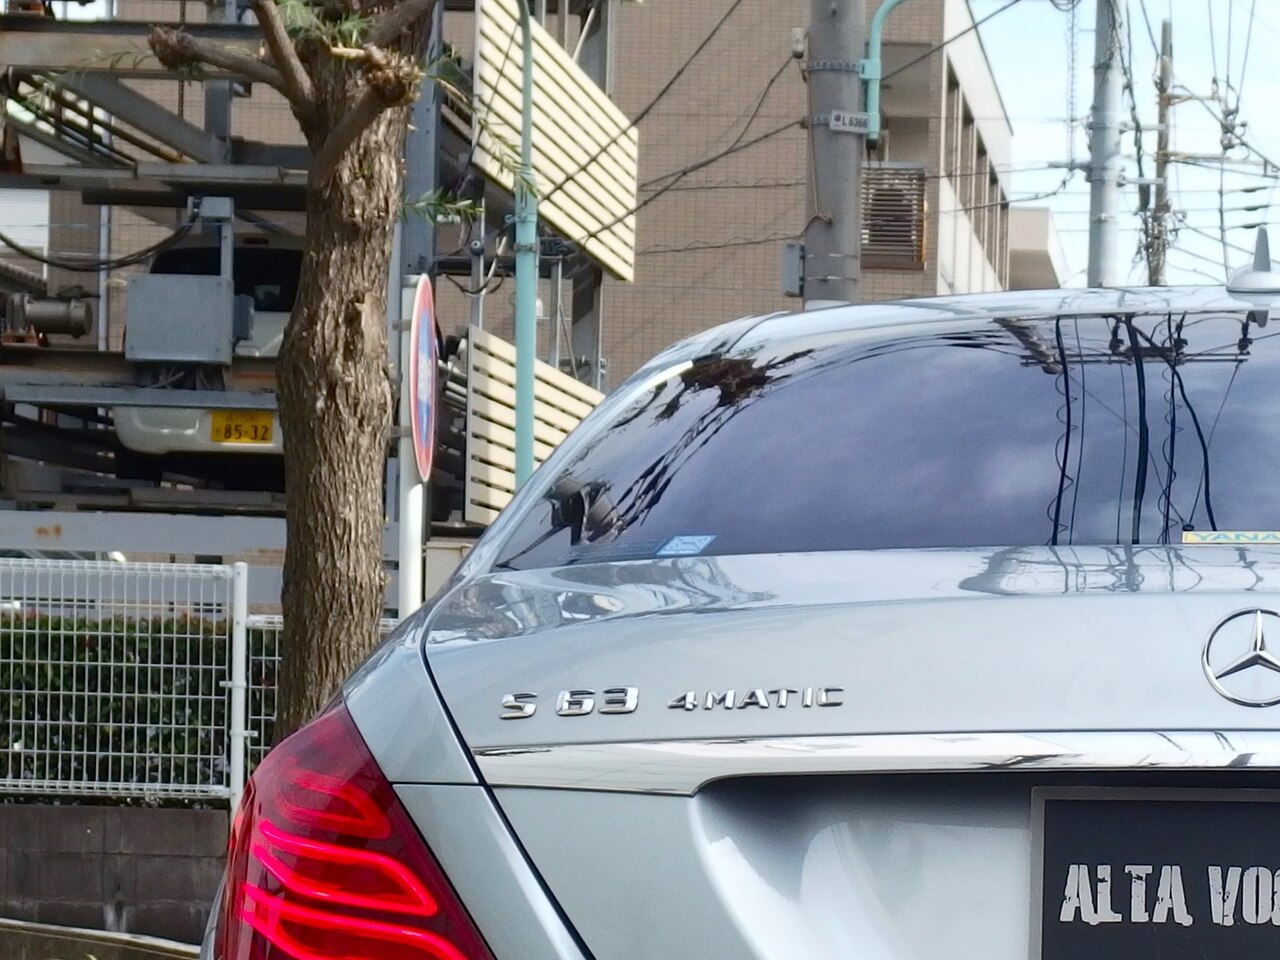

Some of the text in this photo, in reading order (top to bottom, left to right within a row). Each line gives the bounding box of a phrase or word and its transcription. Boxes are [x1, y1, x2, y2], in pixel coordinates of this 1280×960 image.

[499, 686, 844, 719] S 63 4MATIC
[1059, 864, 1193, 926] ALTA
